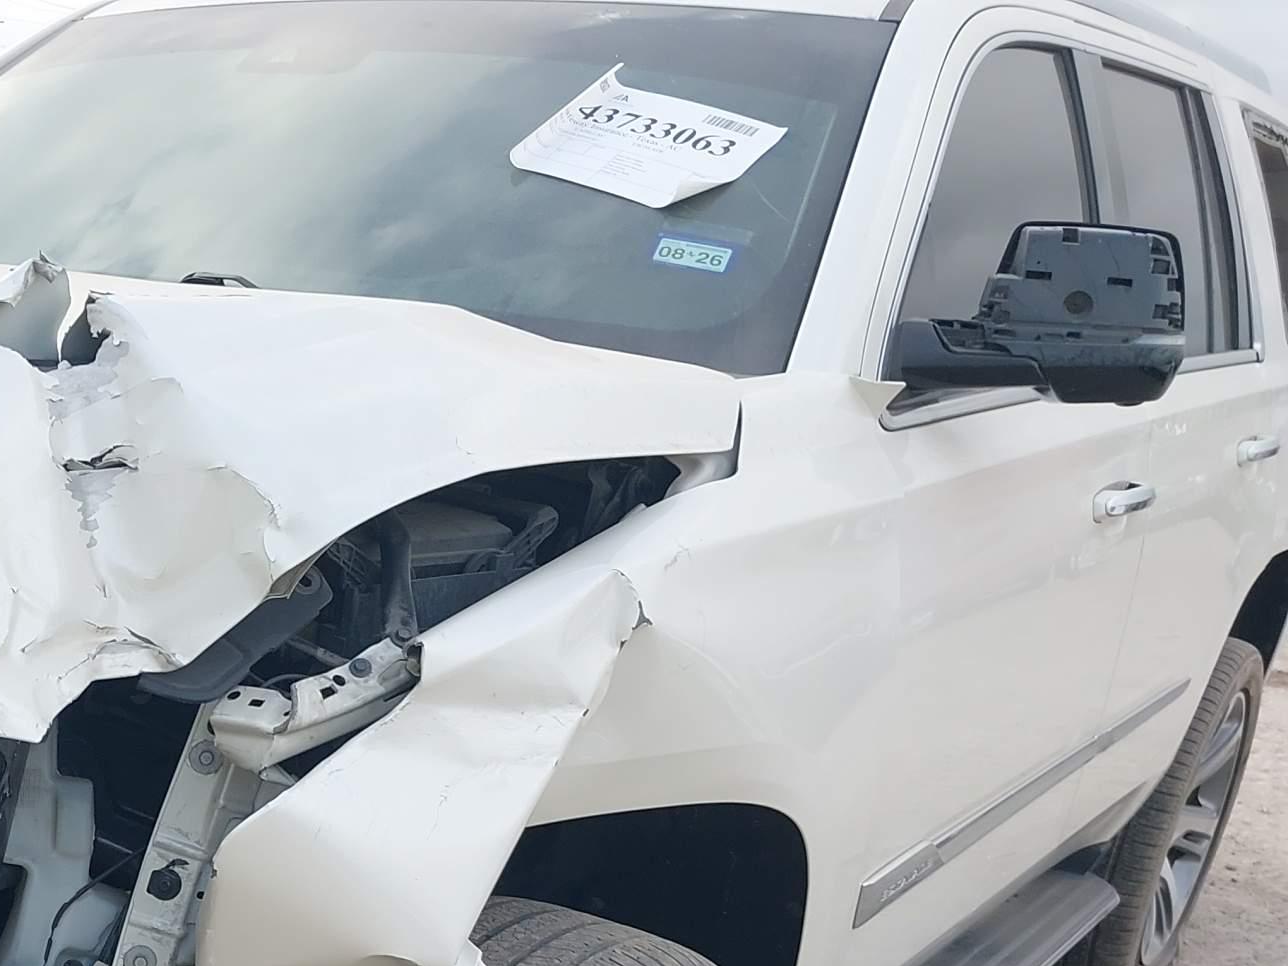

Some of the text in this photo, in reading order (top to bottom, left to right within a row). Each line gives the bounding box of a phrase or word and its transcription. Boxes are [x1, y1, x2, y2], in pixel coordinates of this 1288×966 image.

[578, 104, 737, 157] 43733063
[658, 246, 724, 267] 08 26
